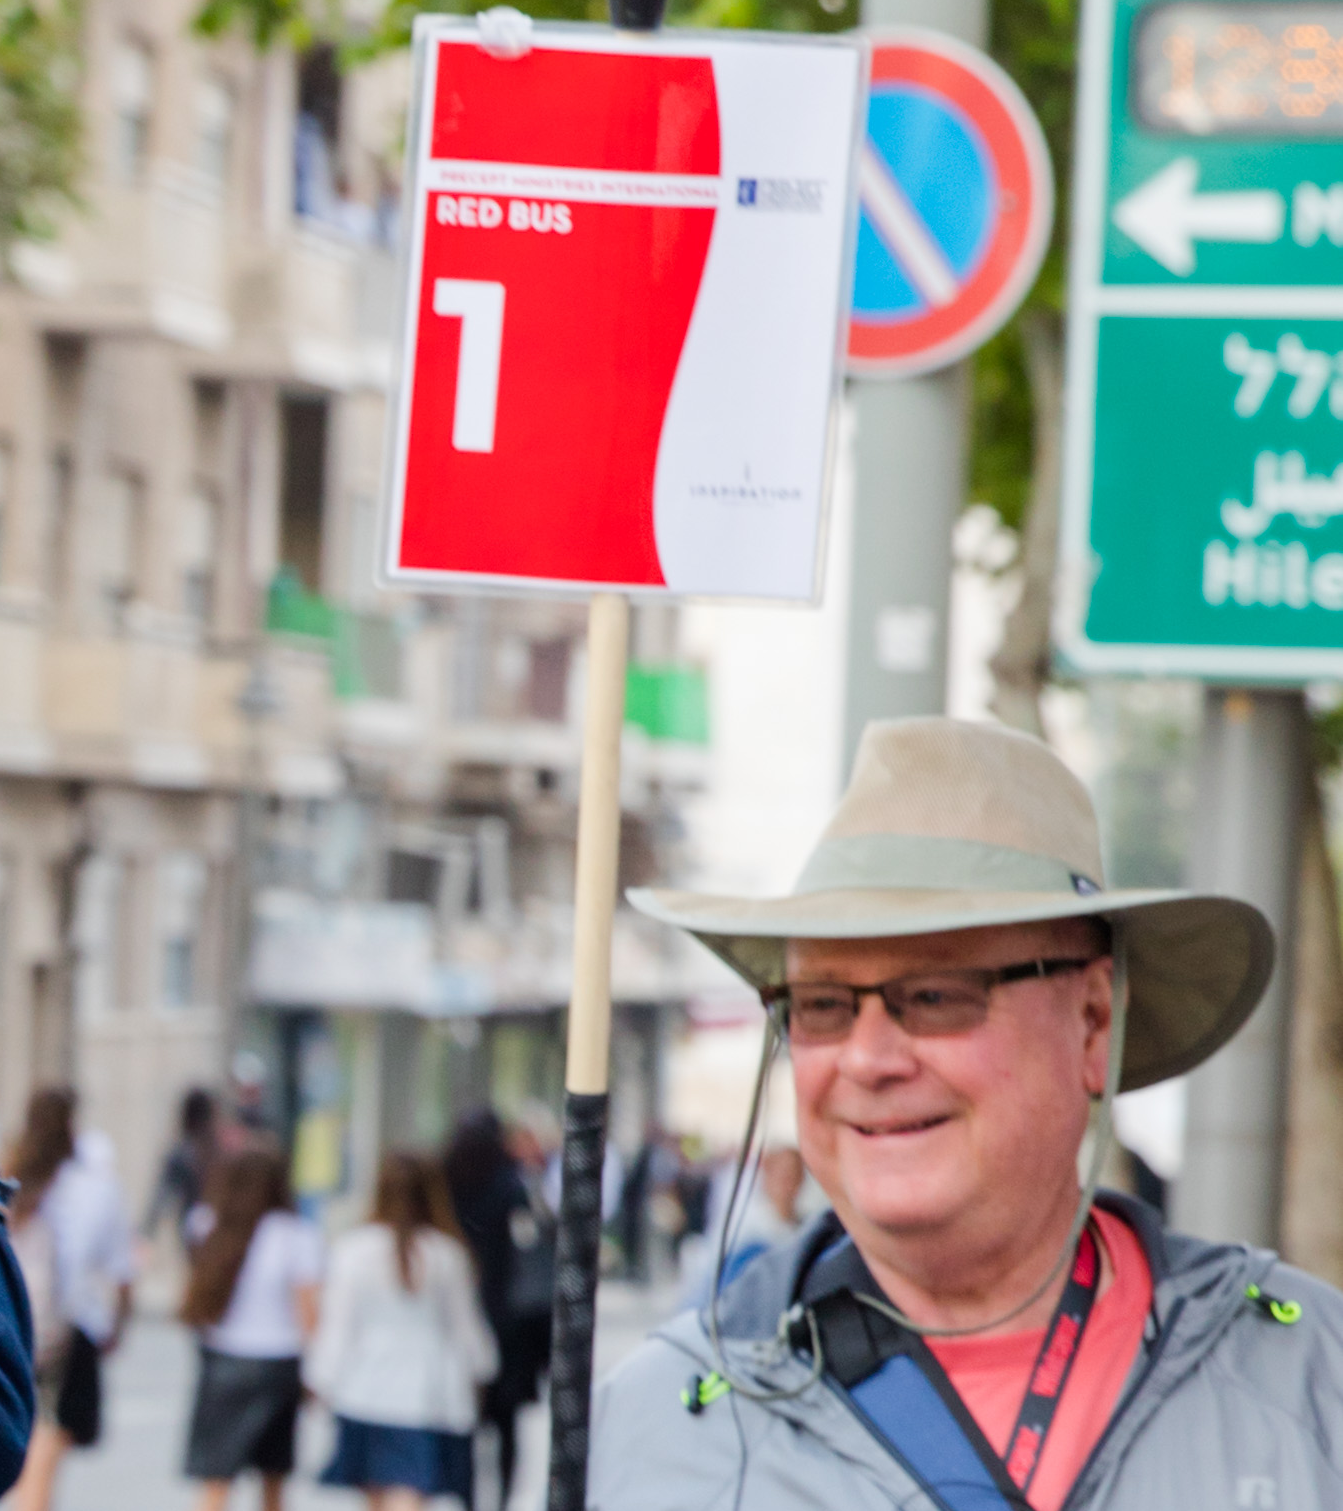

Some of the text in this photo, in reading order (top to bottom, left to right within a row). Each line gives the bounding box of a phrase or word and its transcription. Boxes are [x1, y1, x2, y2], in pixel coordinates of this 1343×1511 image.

[436, 194, 573, 235] RED BUS
[433, 277, 507, 454] 1
